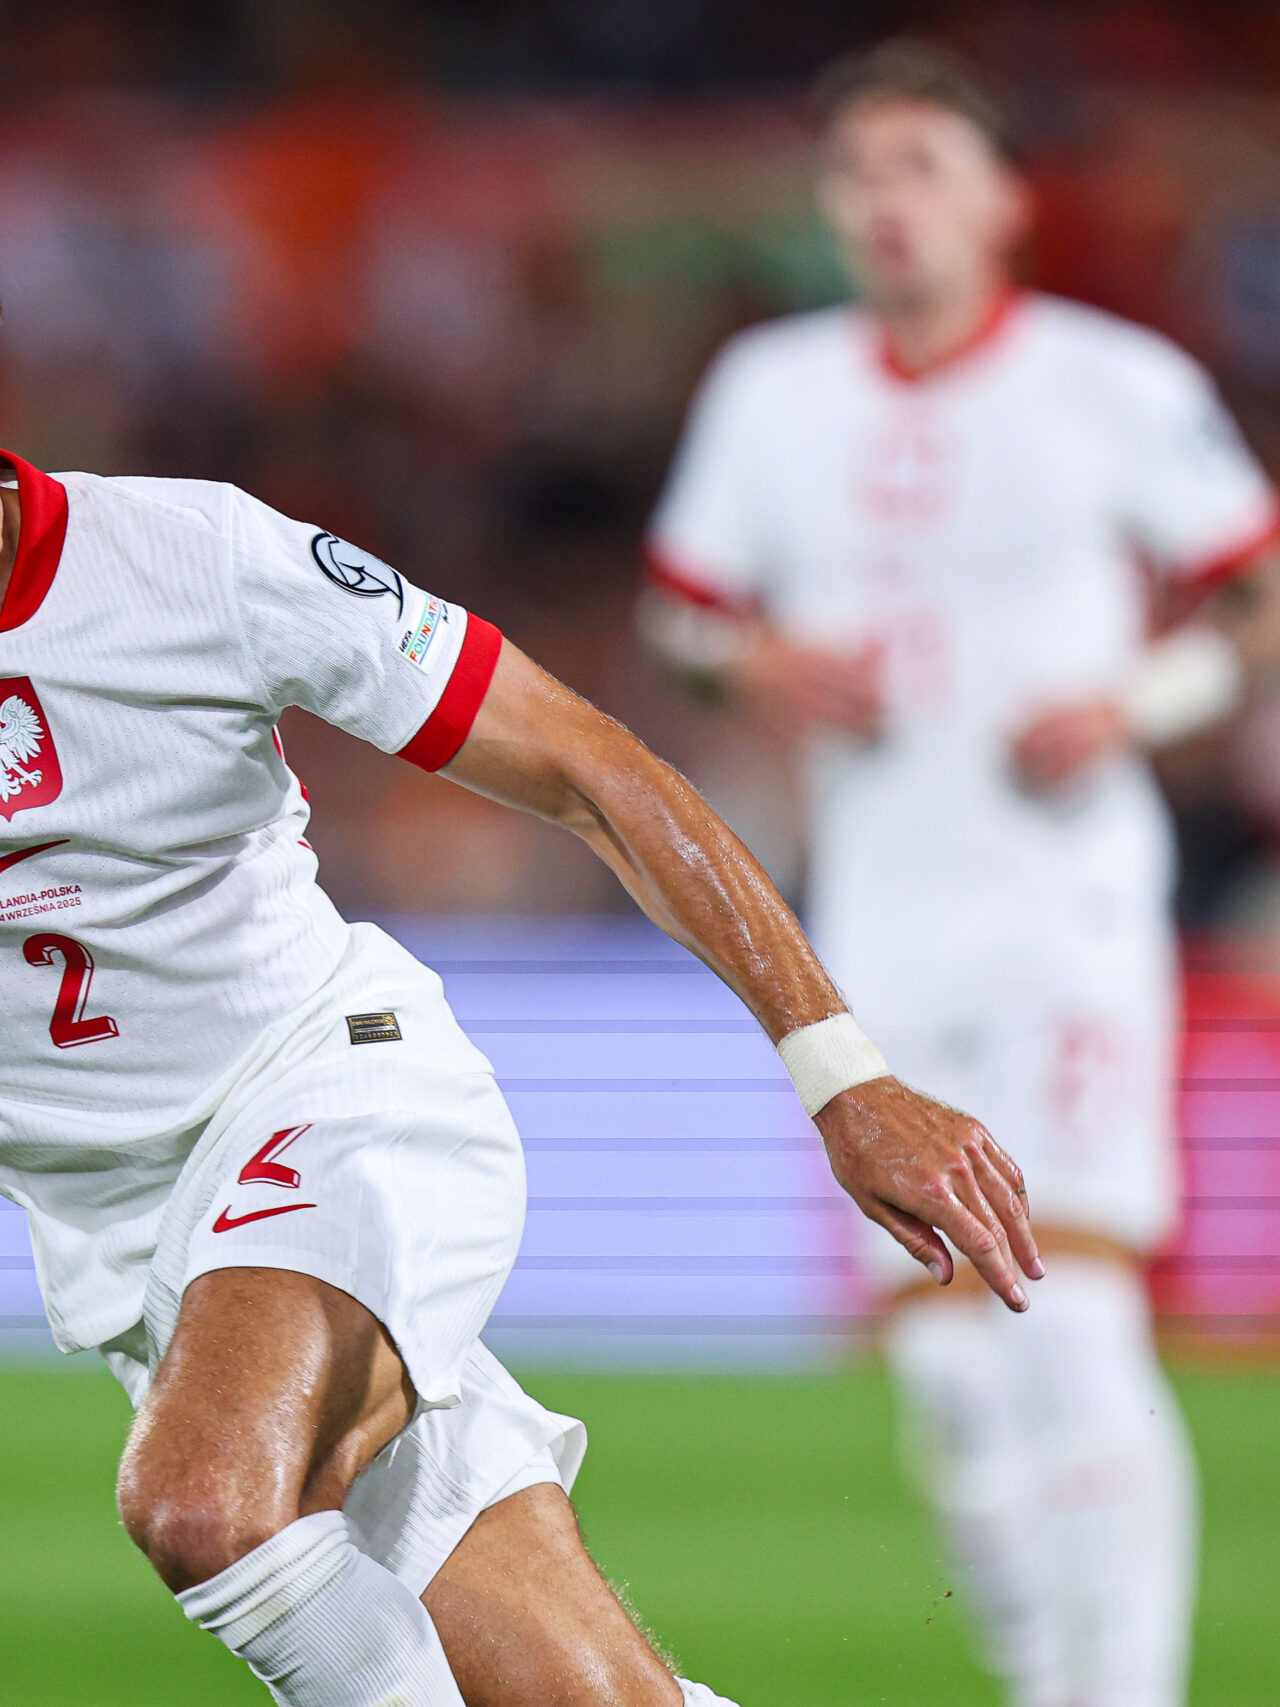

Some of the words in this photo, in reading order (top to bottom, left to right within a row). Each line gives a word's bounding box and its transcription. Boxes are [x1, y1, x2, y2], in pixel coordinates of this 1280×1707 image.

[399, 630, 413, 653] UEFA
[409, 597, 439, 664] FOUNDAT
[5, 903, 57, 921] WRZEŚNIA
[56, 896, 82, 909] 2025
[22, 933, 120, 1049] 2
